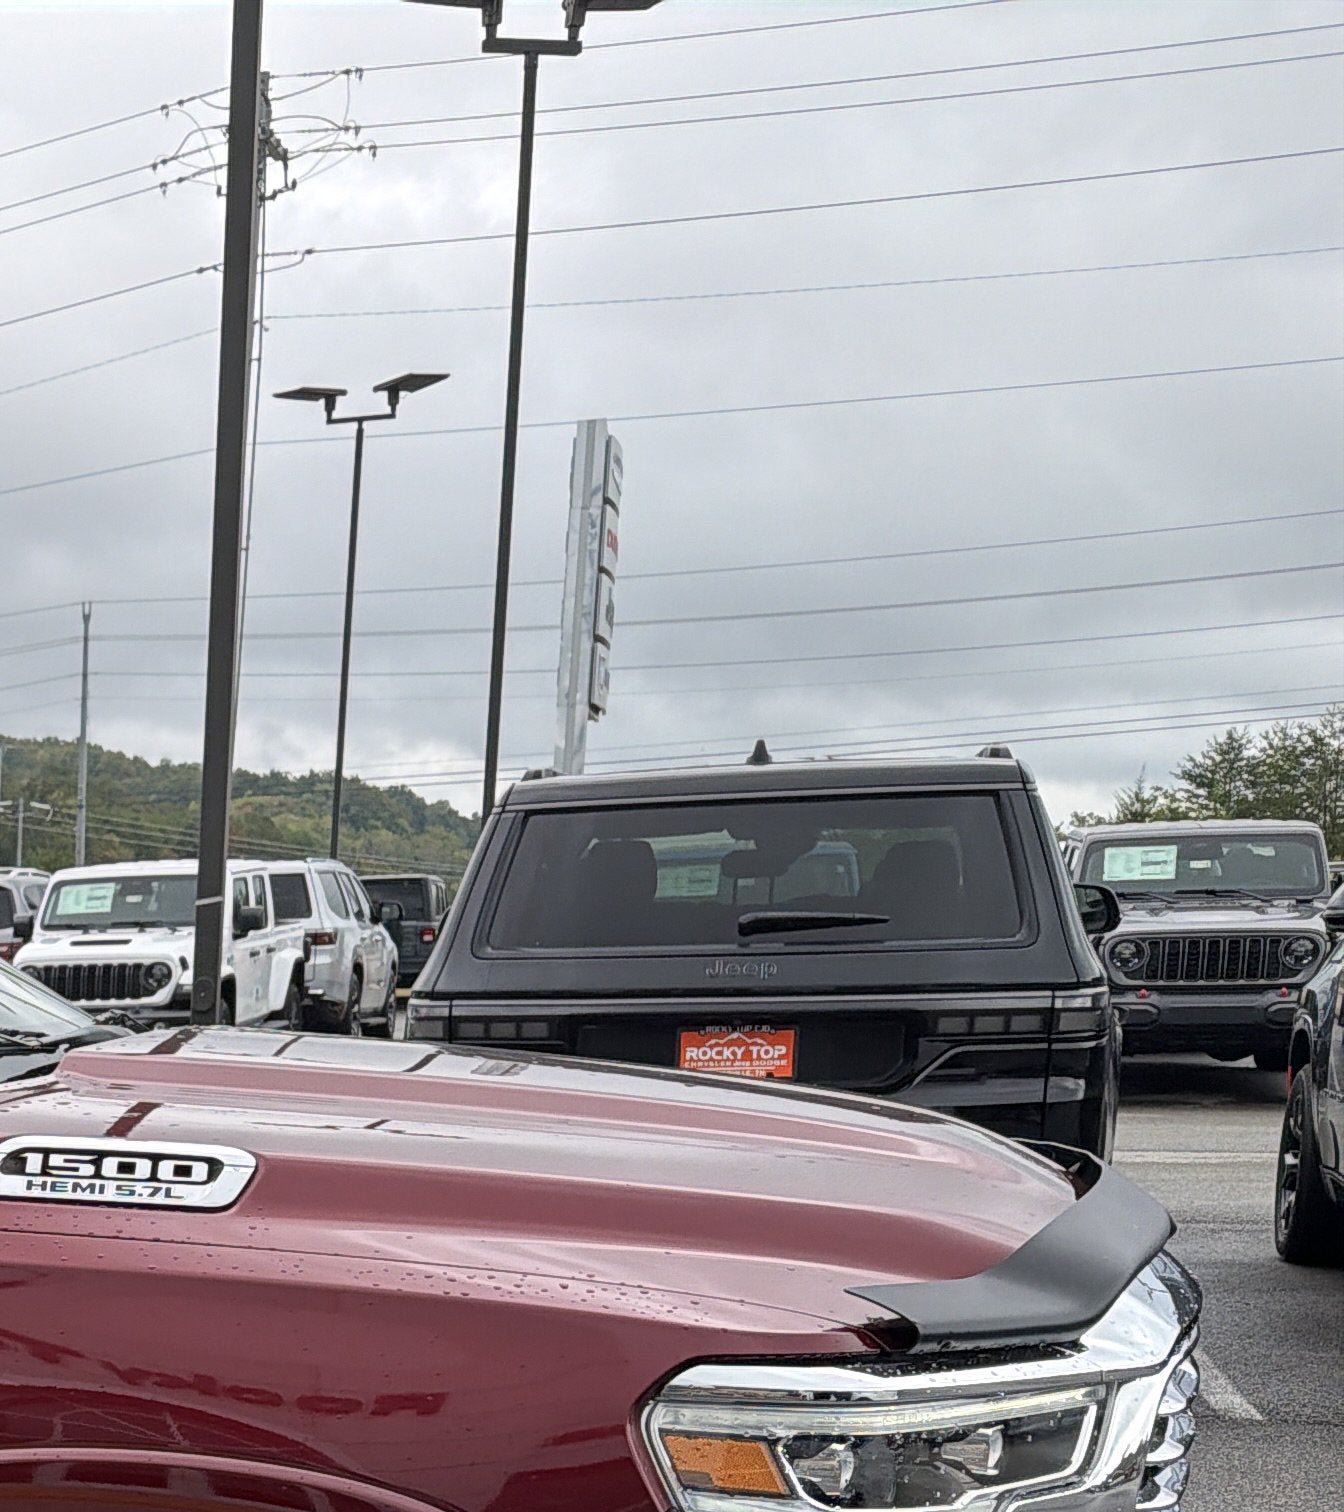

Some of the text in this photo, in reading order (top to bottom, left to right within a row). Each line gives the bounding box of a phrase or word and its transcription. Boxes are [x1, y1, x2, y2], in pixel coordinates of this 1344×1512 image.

[705, 960, 777, 980] Jeep
[685, 1045, 787, 1061] ROCKY TOP
[19, 1152, 210, 1184] 1500
[25, 1179, 185, 1200] HEMI 5.7L
